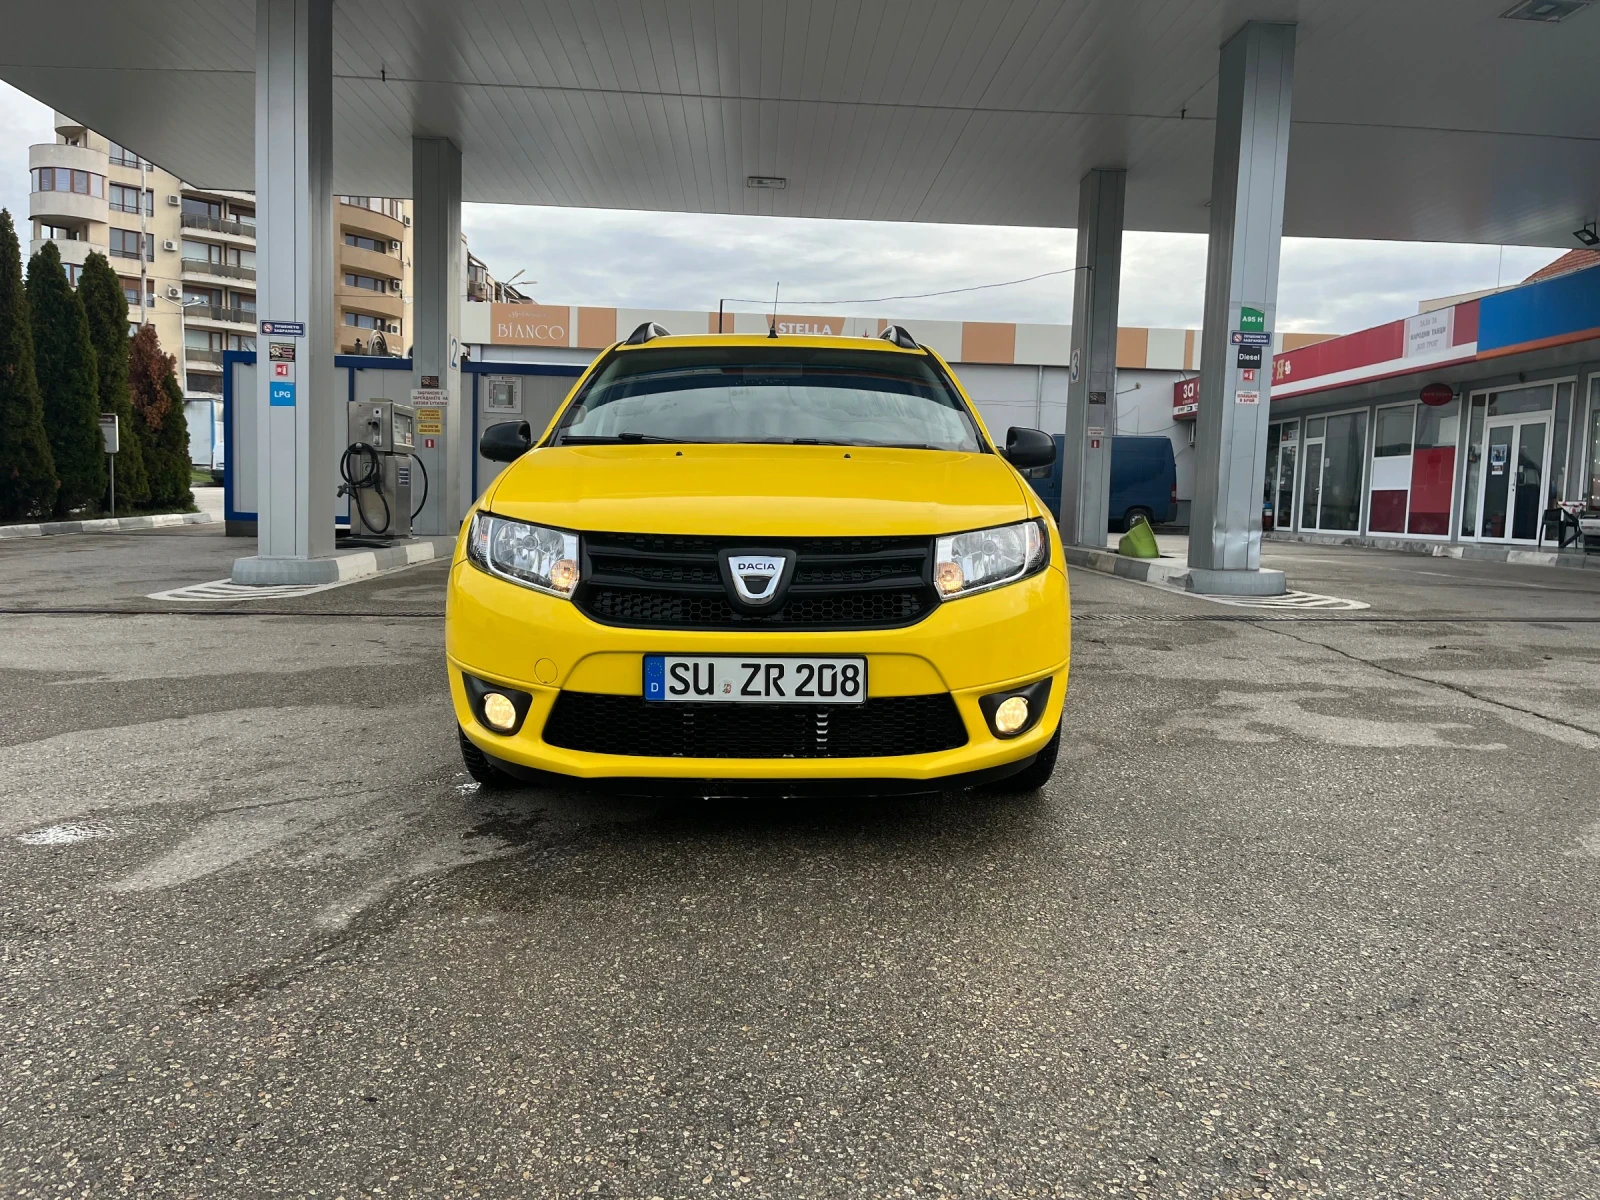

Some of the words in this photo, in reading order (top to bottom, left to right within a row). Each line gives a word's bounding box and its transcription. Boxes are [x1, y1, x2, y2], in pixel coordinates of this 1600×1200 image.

[778, 322, 832, 335] STELLA
[451, 338, 458, 368] 2
[1239, 353, 1260, 361] Diesel
[1072, 351, 1079, 381] 3
[274, 390, 291, 398] LPG
[737, 562, 776, 571] DACIA
[668, 662, 715, 696] SU
[740, 663, 786, 697] ZR
[794, 663, 861, 697] 208
[650, 682, 659, 693] D
